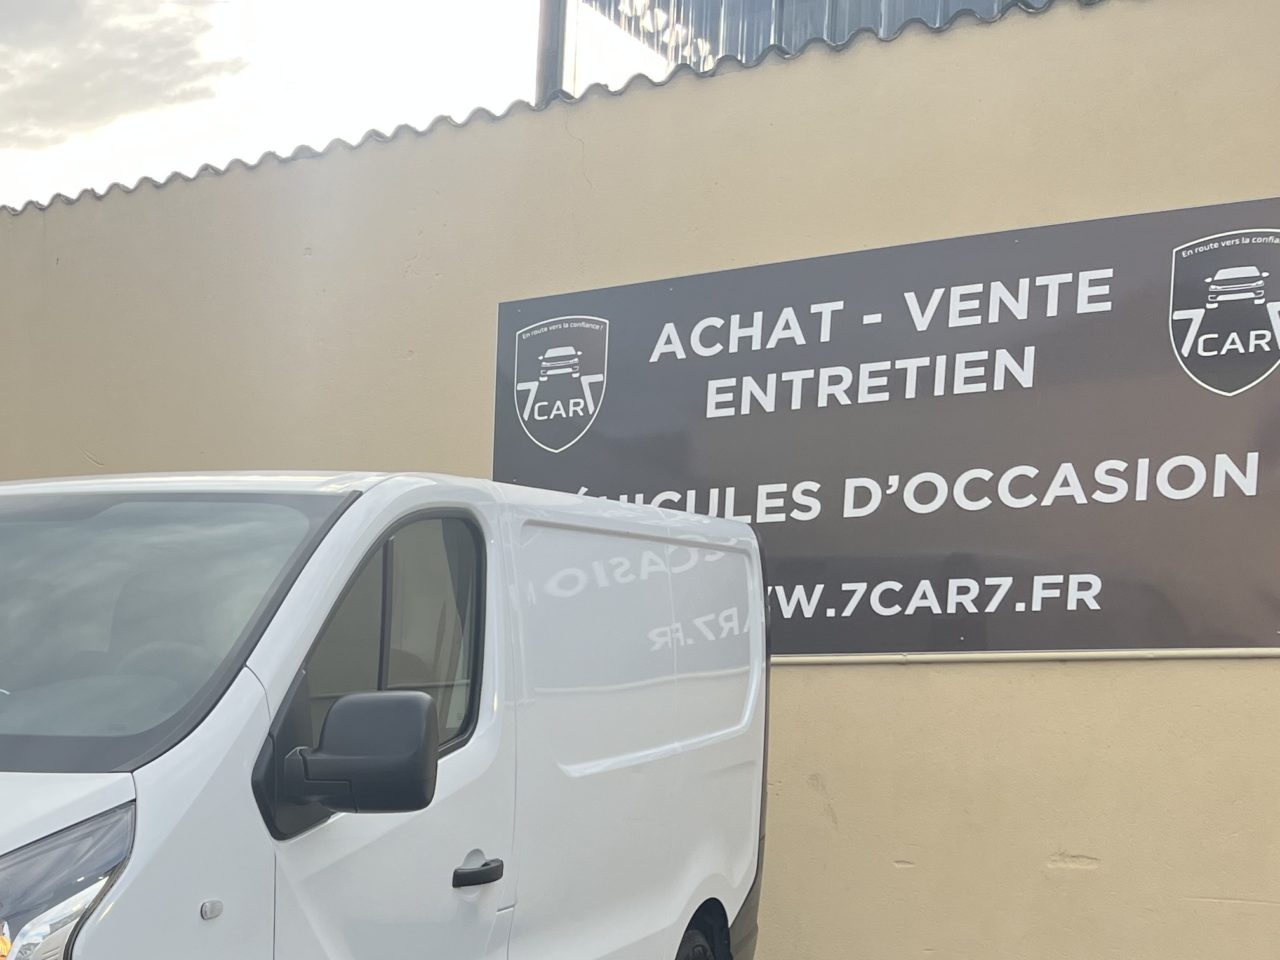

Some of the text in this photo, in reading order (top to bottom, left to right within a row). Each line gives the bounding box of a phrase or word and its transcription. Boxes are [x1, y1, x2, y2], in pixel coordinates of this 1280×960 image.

[1182, 235, 1280, 258] En route vers la confia
[649, 301, 844, 362] ACHAT
[903, 268, 1114, 331] VENTE
[706, 346, 1035, 418] ENTRETIEN
[843, 452, 1259, 518] D’OCCASION
[767, 574, 1102, 618] W.7CAR7.FR
